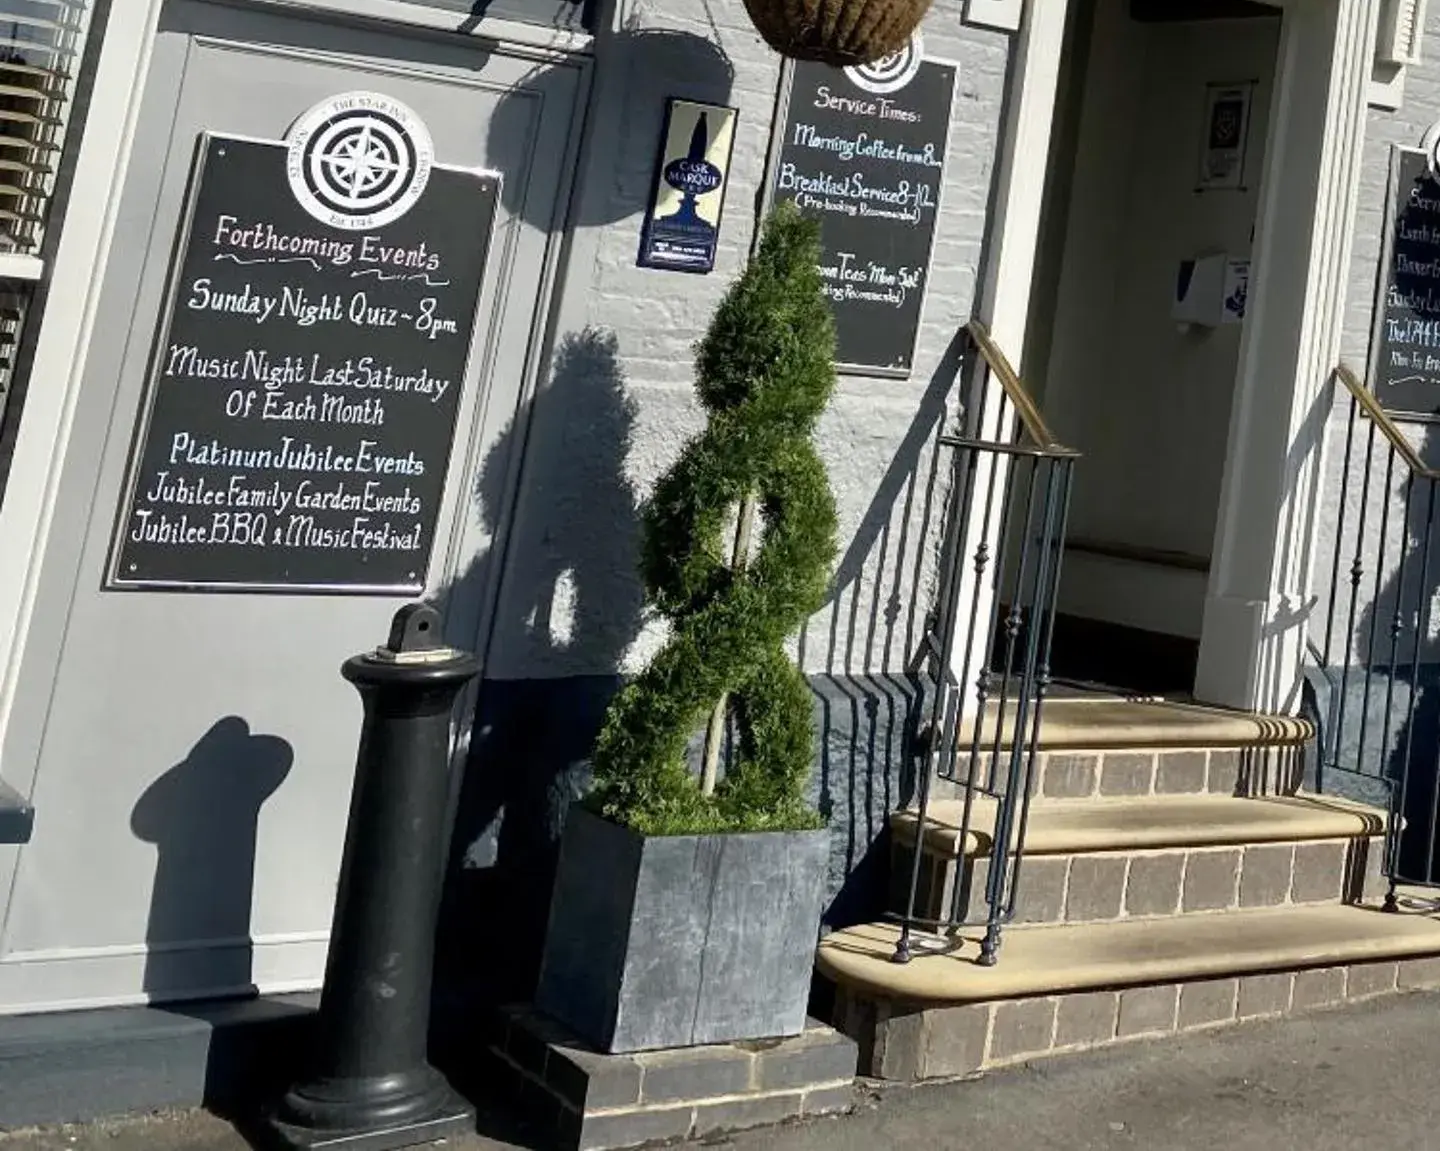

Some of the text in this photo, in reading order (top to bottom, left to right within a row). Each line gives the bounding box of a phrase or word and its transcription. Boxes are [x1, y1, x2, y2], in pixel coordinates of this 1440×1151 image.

[813, 86, 876, 116] Service
[793, 123, 854, 161] Morning
[856, 132, 896, 160] Coffee
[896, 144, 923, 165] from
[667, 171, 719, 186] MARQUE
[680, 161, 709, 174] CASK
[778, 162, 849, 197] Breakfast
[850, 172, 899, 204] Service
[213, 215, 440, 271] Forthcoming Events
[837, 252, 867, 282] Teas
[187, 278, 276, 324] Sunday
[278, 285, 343, 326] Night
[349, 292, 397, 327] Quiz
[415, 298, 458, 339] 8pm
[166, 344, 449, 403] Music Night Last Saturday
[225, 389, 385, 425] Of Each Month
[272, 436, 353, 472] Jubilee
[354, 439, 426, 476] Events
[147, 471, 421, 516] Jubilee Family Garden Events
[131, 510, 206, 545] Jubilee
[207, 512, 268, 546] BBQ
[283, 514, 350, 548] Music
[350, 517, 422, 550] Festival
